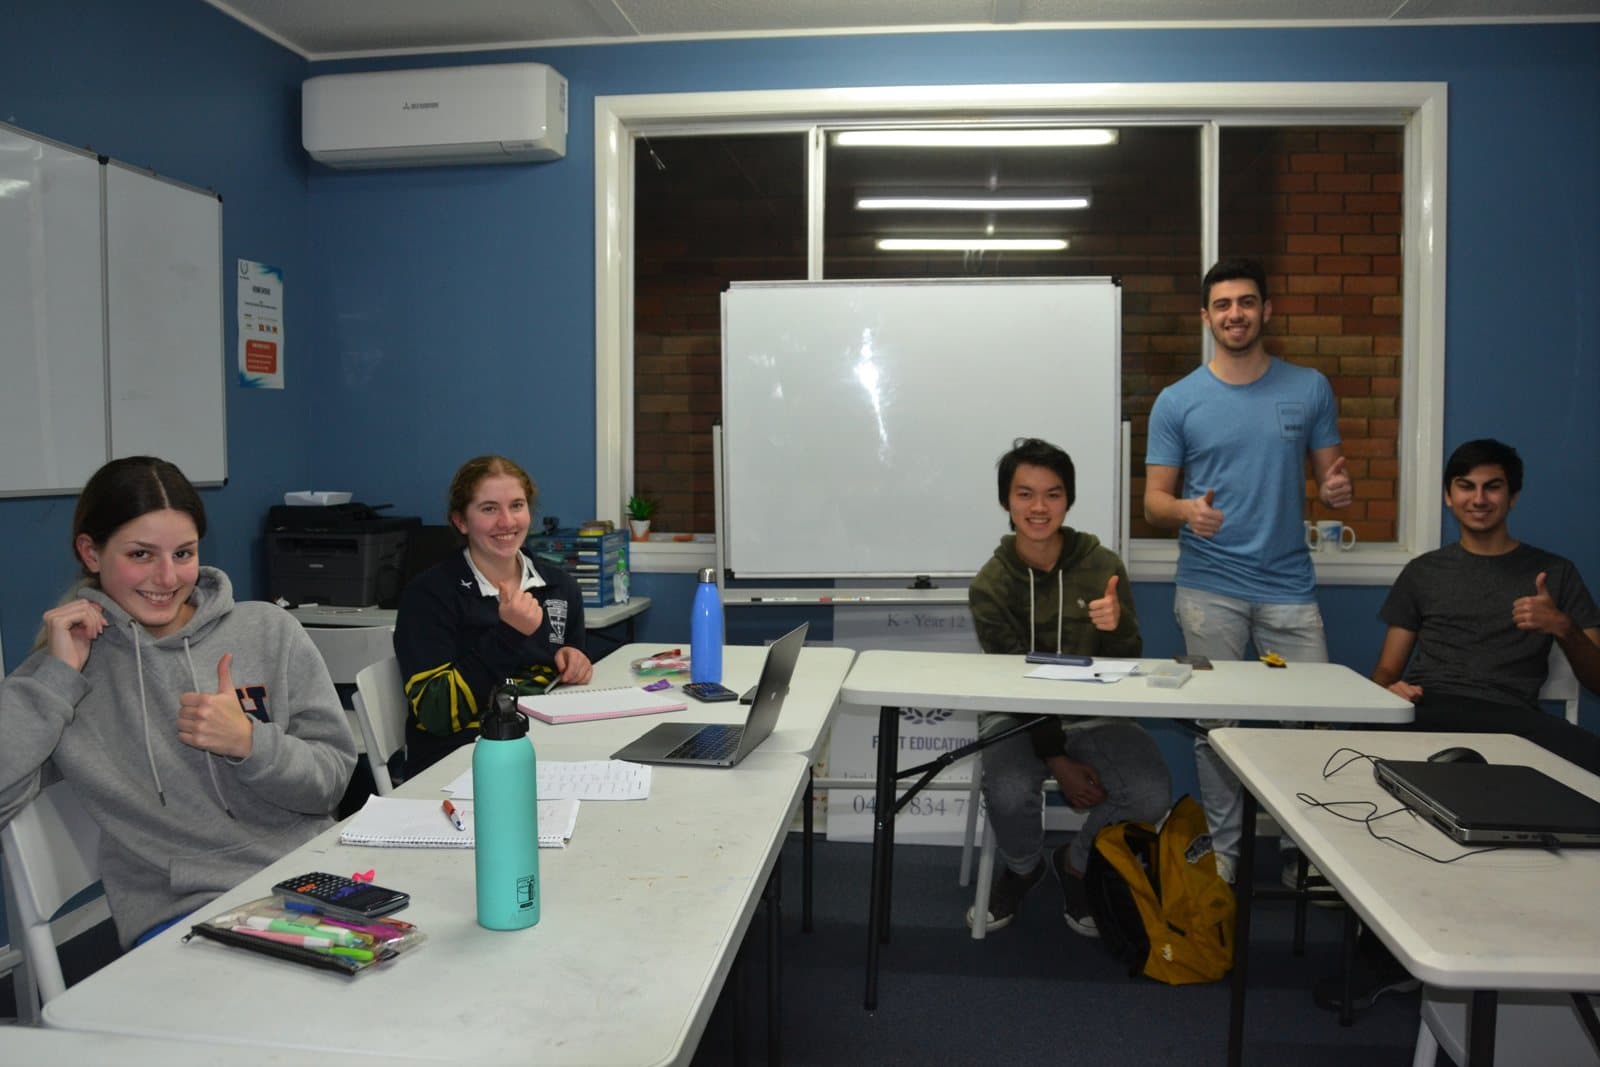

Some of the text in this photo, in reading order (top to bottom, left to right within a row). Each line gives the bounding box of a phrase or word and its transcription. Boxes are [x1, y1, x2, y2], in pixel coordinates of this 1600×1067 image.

[888, 613, 900, 627] K
[913, 614, 944, 627] Year
[910, 796, 947, 816] 834
